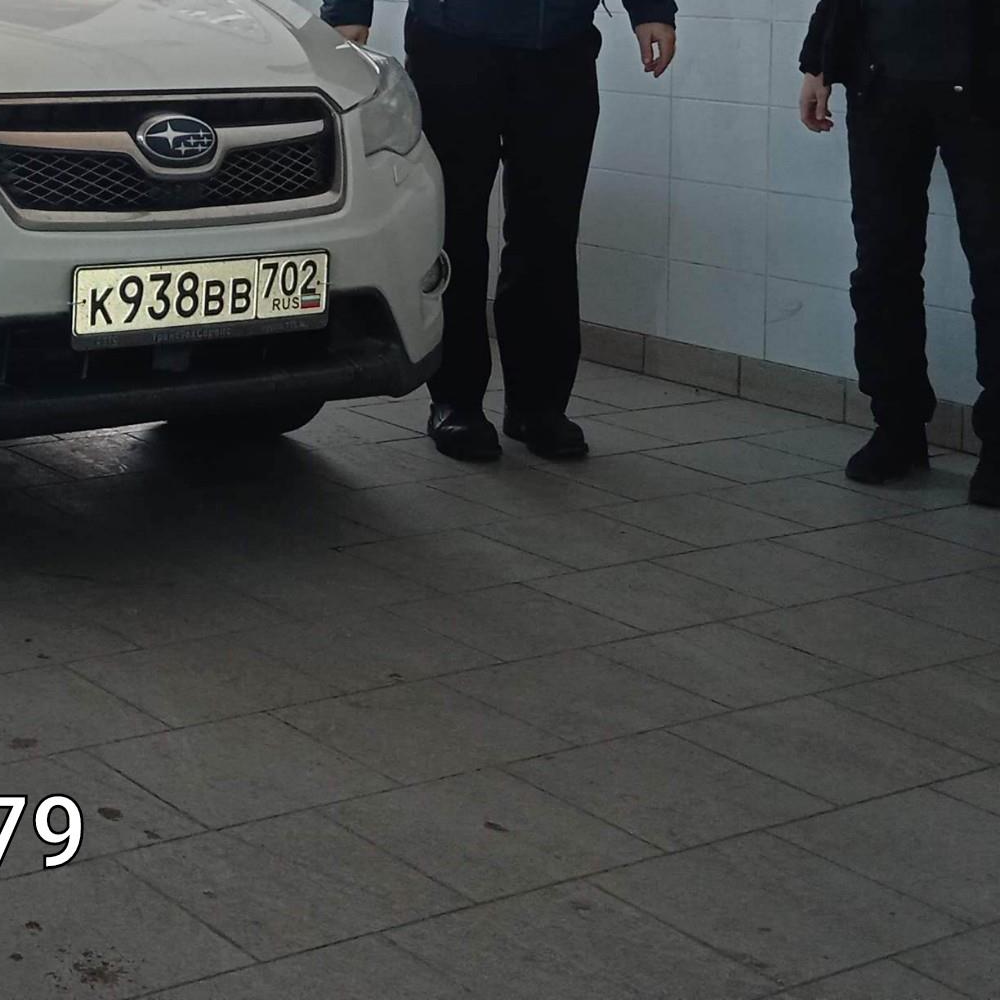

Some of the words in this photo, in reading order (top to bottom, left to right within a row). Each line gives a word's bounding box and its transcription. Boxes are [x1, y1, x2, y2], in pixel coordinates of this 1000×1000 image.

[90, 271, 252, 326] К938ВВ
[262, 260, 318, 298] 702
[272, 296, 300, 311] RUS
